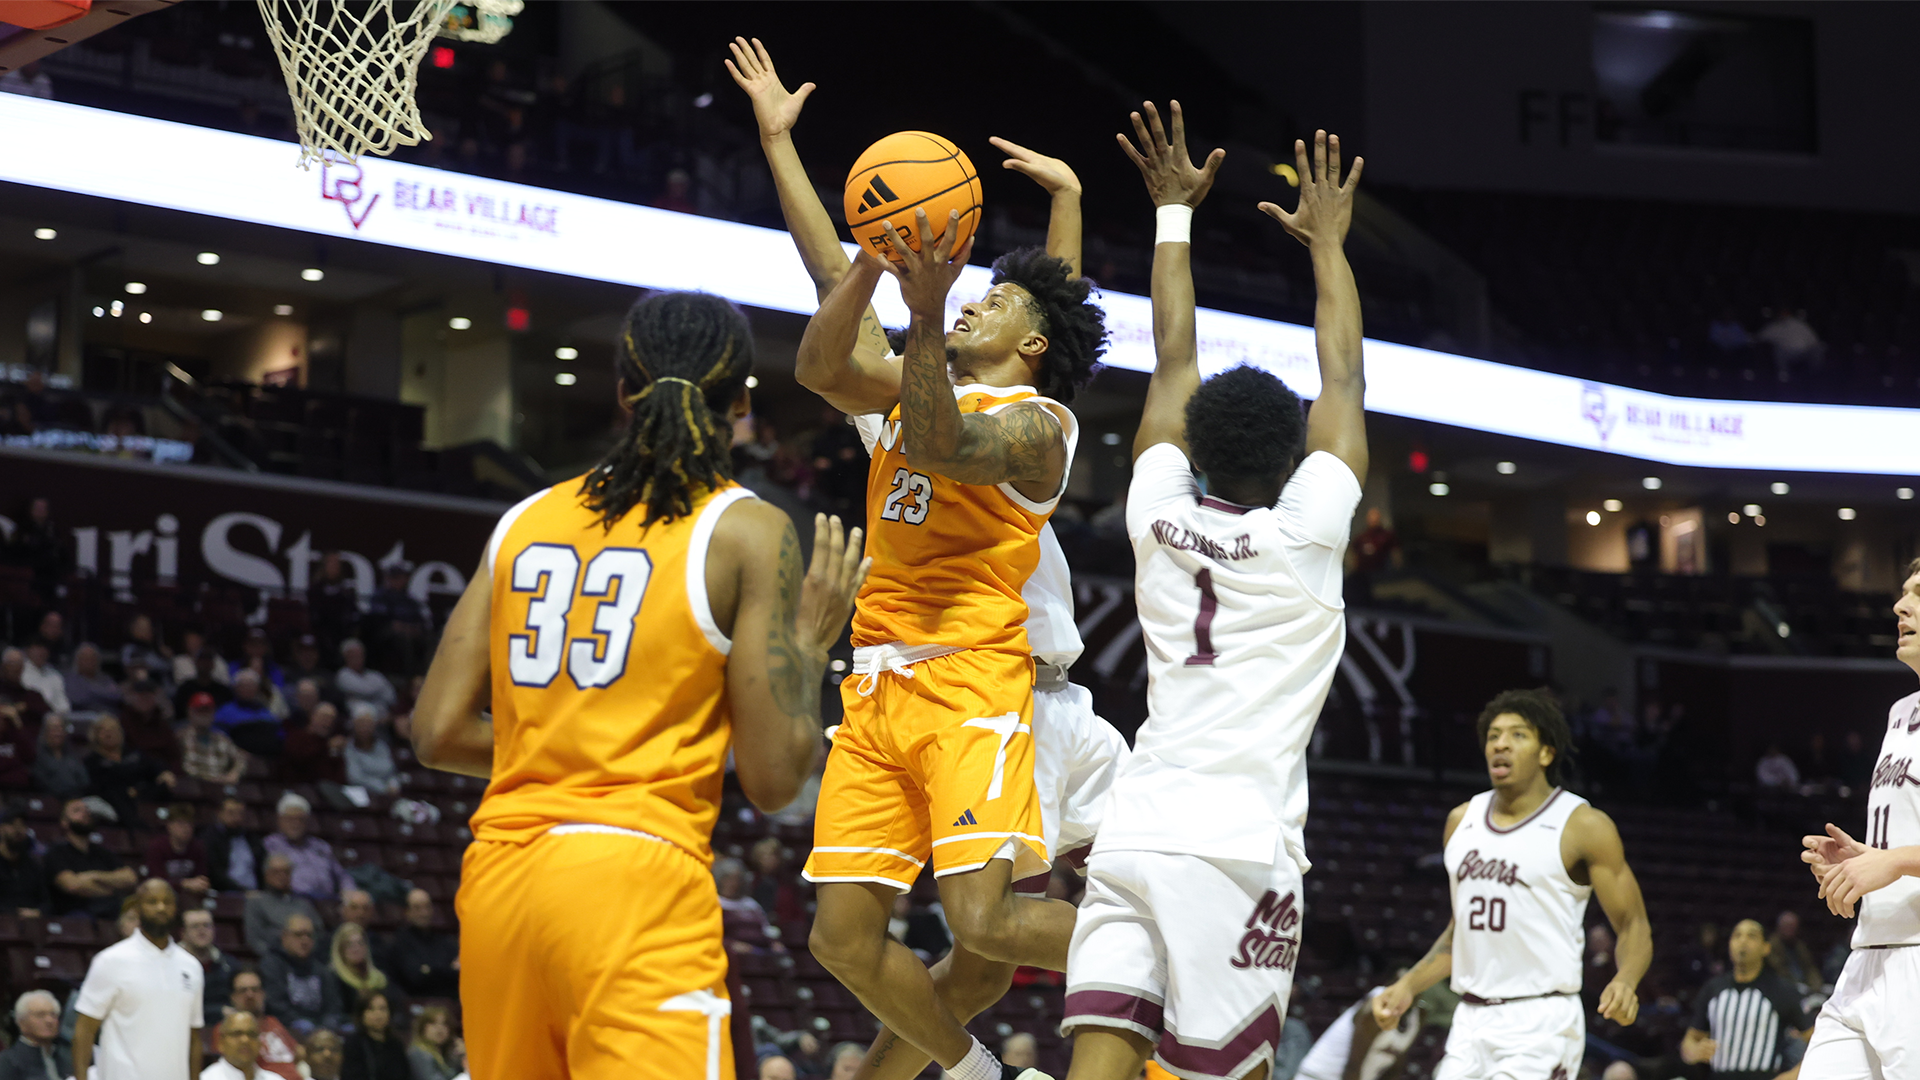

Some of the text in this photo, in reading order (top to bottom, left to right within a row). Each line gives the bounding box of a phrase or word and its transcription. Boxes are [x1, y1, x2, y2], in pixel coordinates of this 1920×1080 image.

[394, 180, 457, 212] BEAR
[464, 192, 558, 234] VILLAGE
[880, 467, 933, 526] 23
[509, 542, 653, 691] 33
[1183, 566, 1220, 668] 1
[1871, 803, 1891, 850] 11
[1456, 848, 1532, 889] Bears
[1244, 888, 1300, 932] Mo
[1469, 896, 1507, 933] 20
